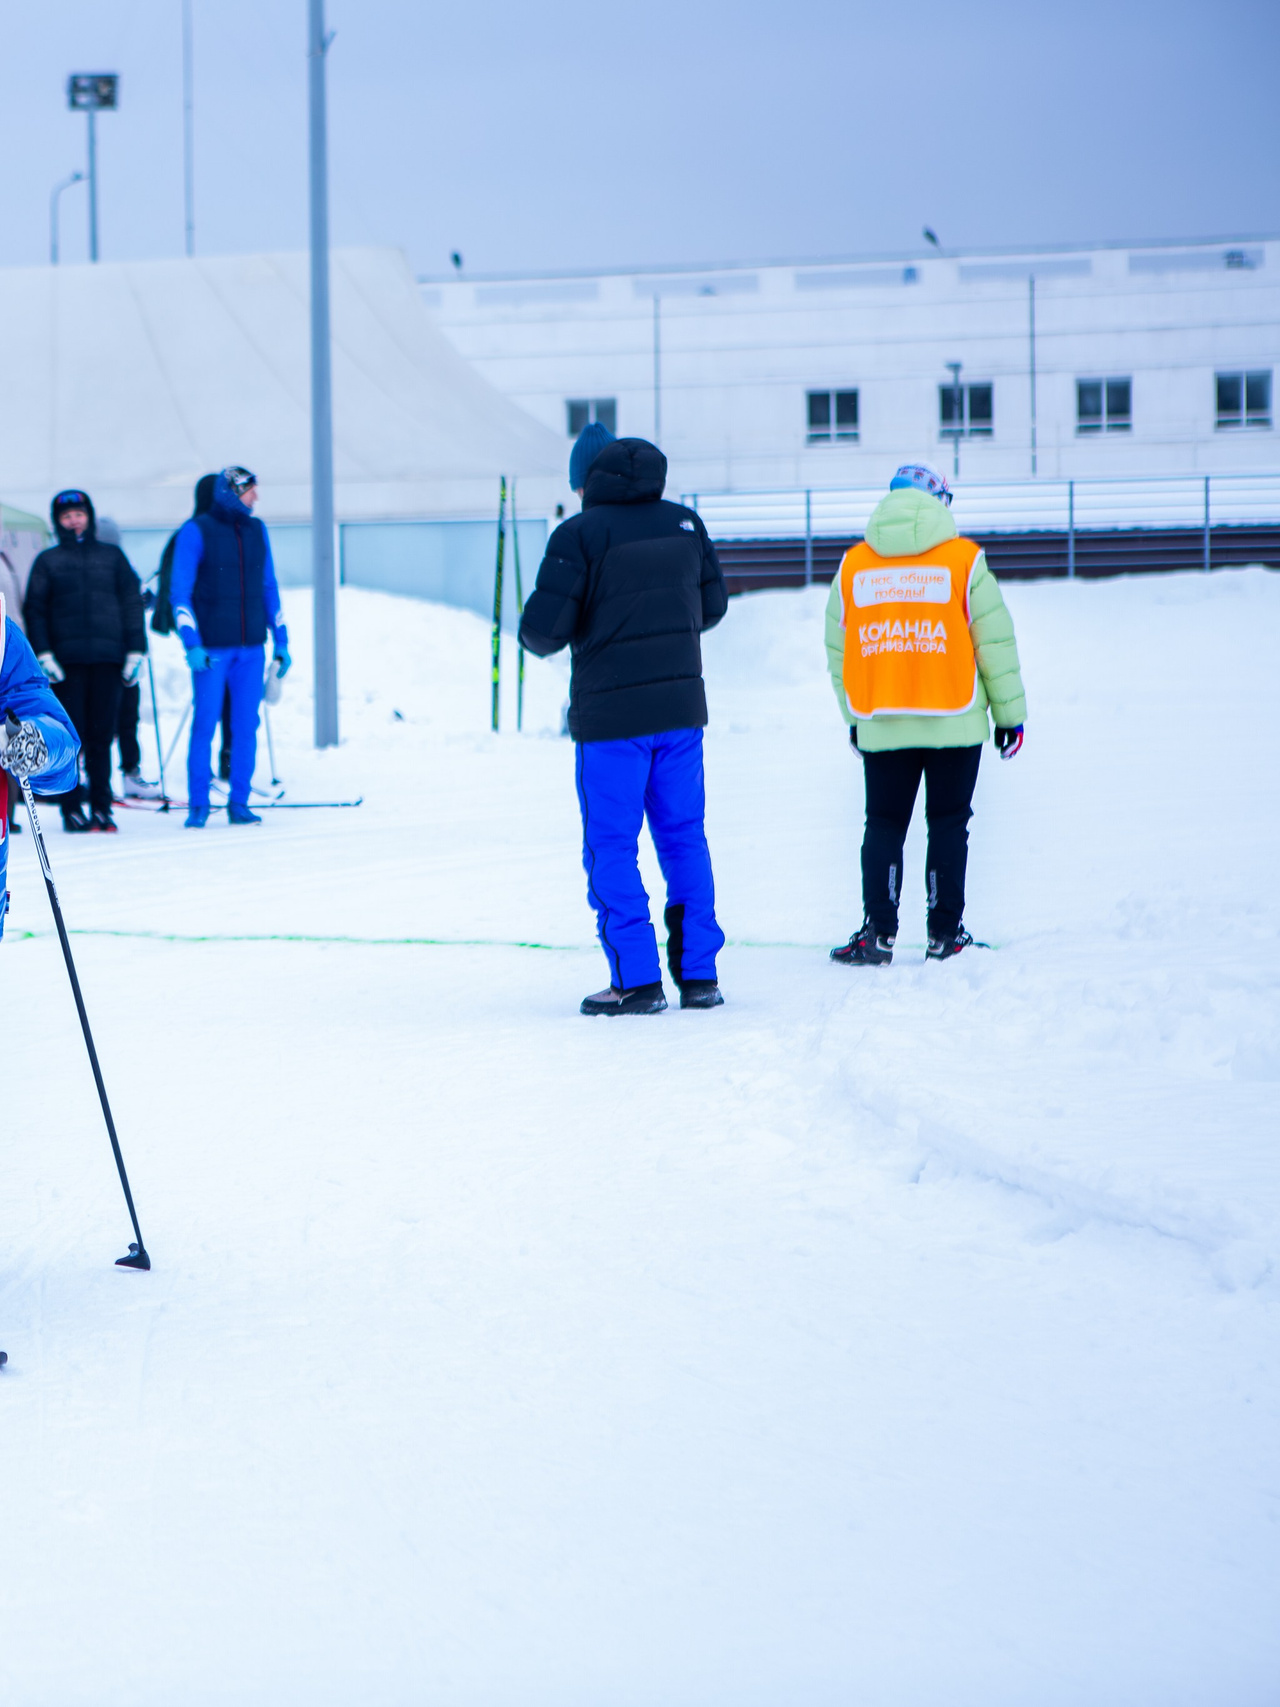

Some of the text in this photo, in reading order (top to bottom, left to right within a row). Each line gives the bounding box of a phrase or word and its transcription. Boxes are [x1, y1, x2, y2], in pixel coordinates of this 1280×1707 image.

[859, 572, 945, 588] У нас общие
[874, 586, 926, 600] победы!
